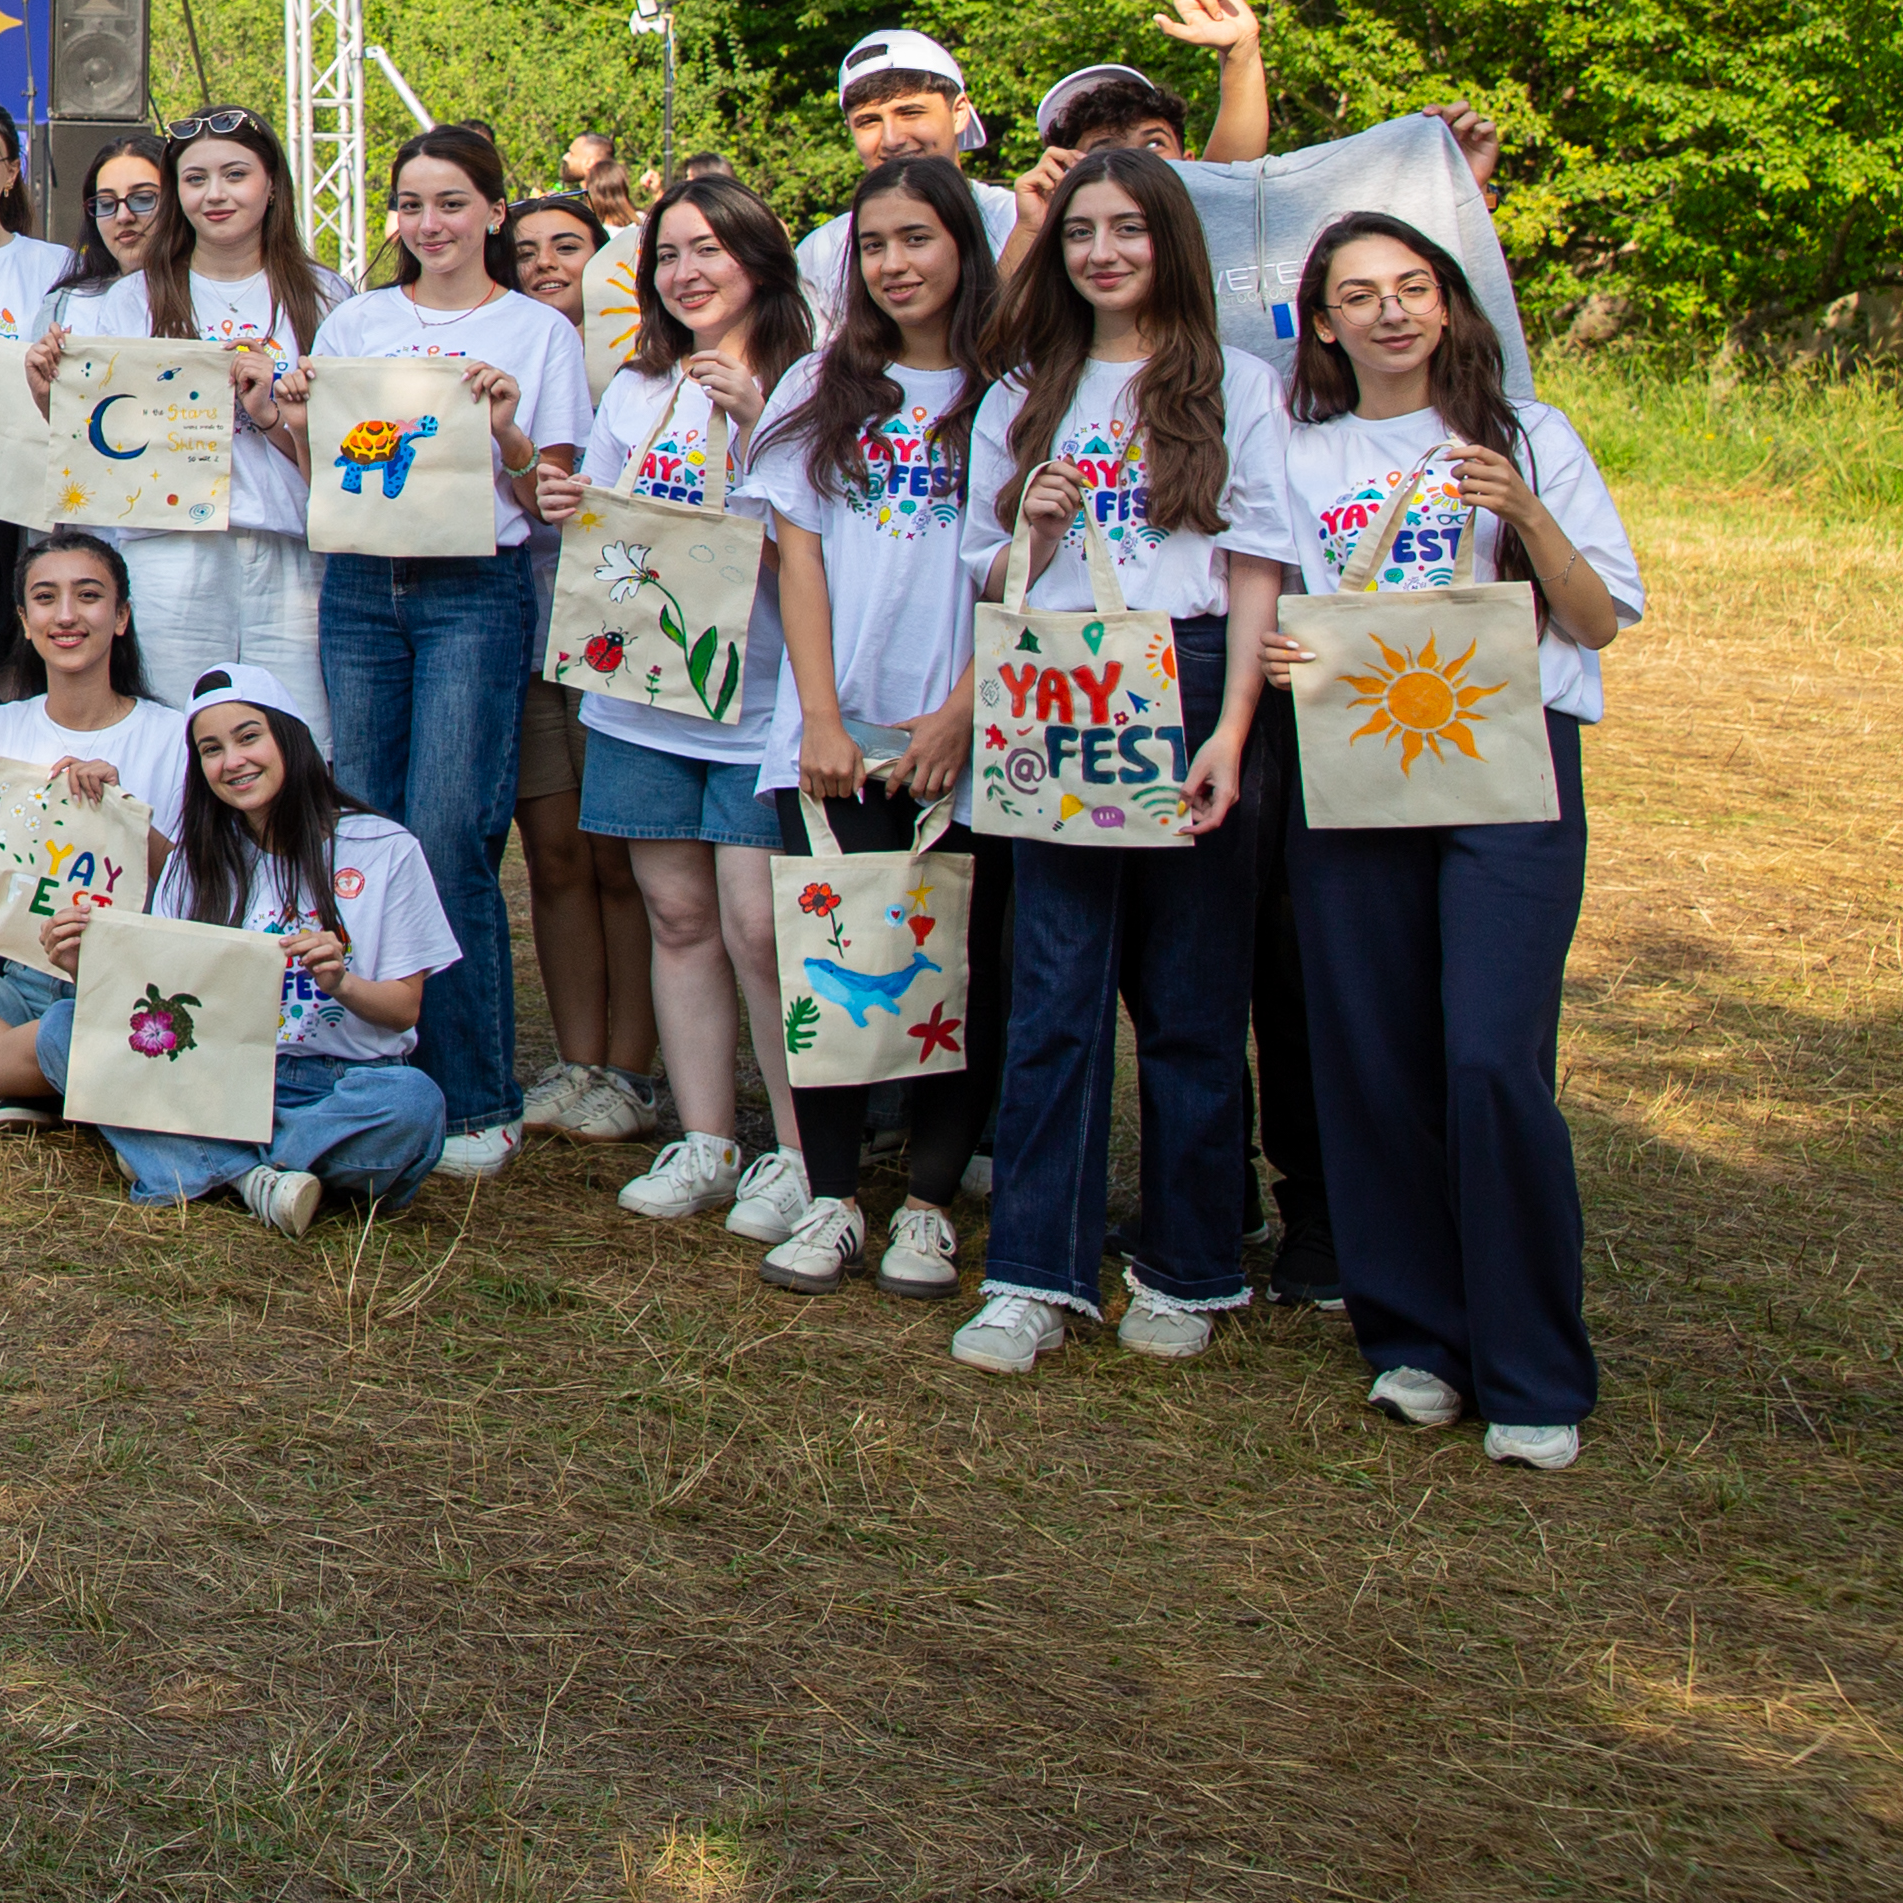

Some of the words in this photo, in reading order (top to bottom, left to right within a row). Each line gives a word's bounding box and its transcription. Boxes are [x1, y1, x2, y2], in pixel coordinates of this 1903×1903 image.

[168, 403, 218, 422] Stars
[168, 431, 218, 452] Shine
[997, 658, 1125, 724] YAY
[45, 840, 123, 894] YAY
